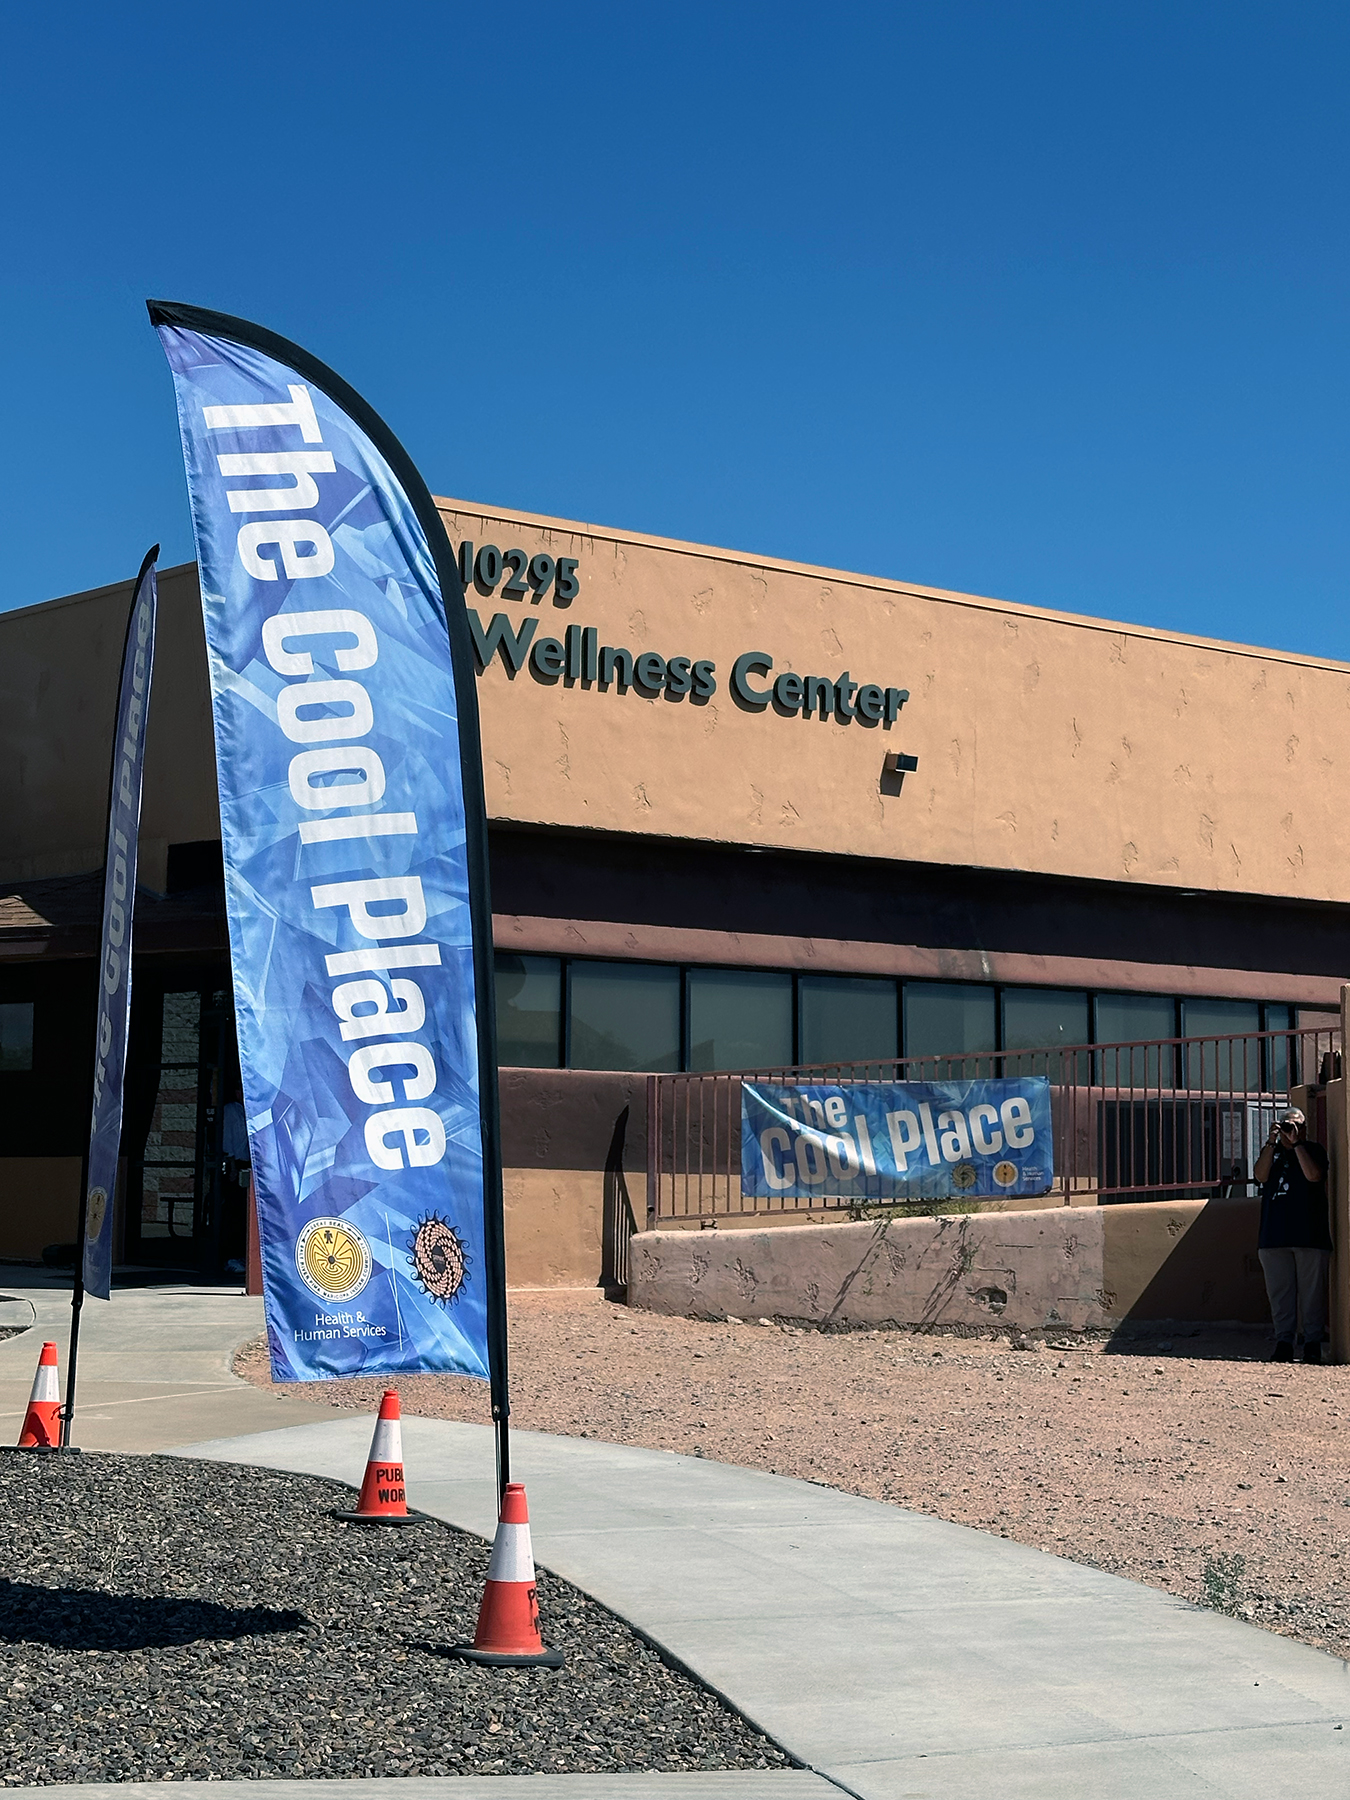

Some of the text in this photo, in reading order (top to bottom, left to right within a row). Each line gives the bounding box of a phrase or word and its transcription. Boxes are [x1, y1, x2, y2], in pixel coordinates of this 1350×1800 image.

[460, 540, 580, 600] 10295
[466, 608, 910, 723] Wellness Center
[201, 383, 446, 1171] The Cool Place
[779, 1094, 848, 1131] The
[760, 1097, 1035, 1190] Cool Place
[294, 1323, 387, 1342] Human Services
[315, 1310, 366, 1326] Health &
